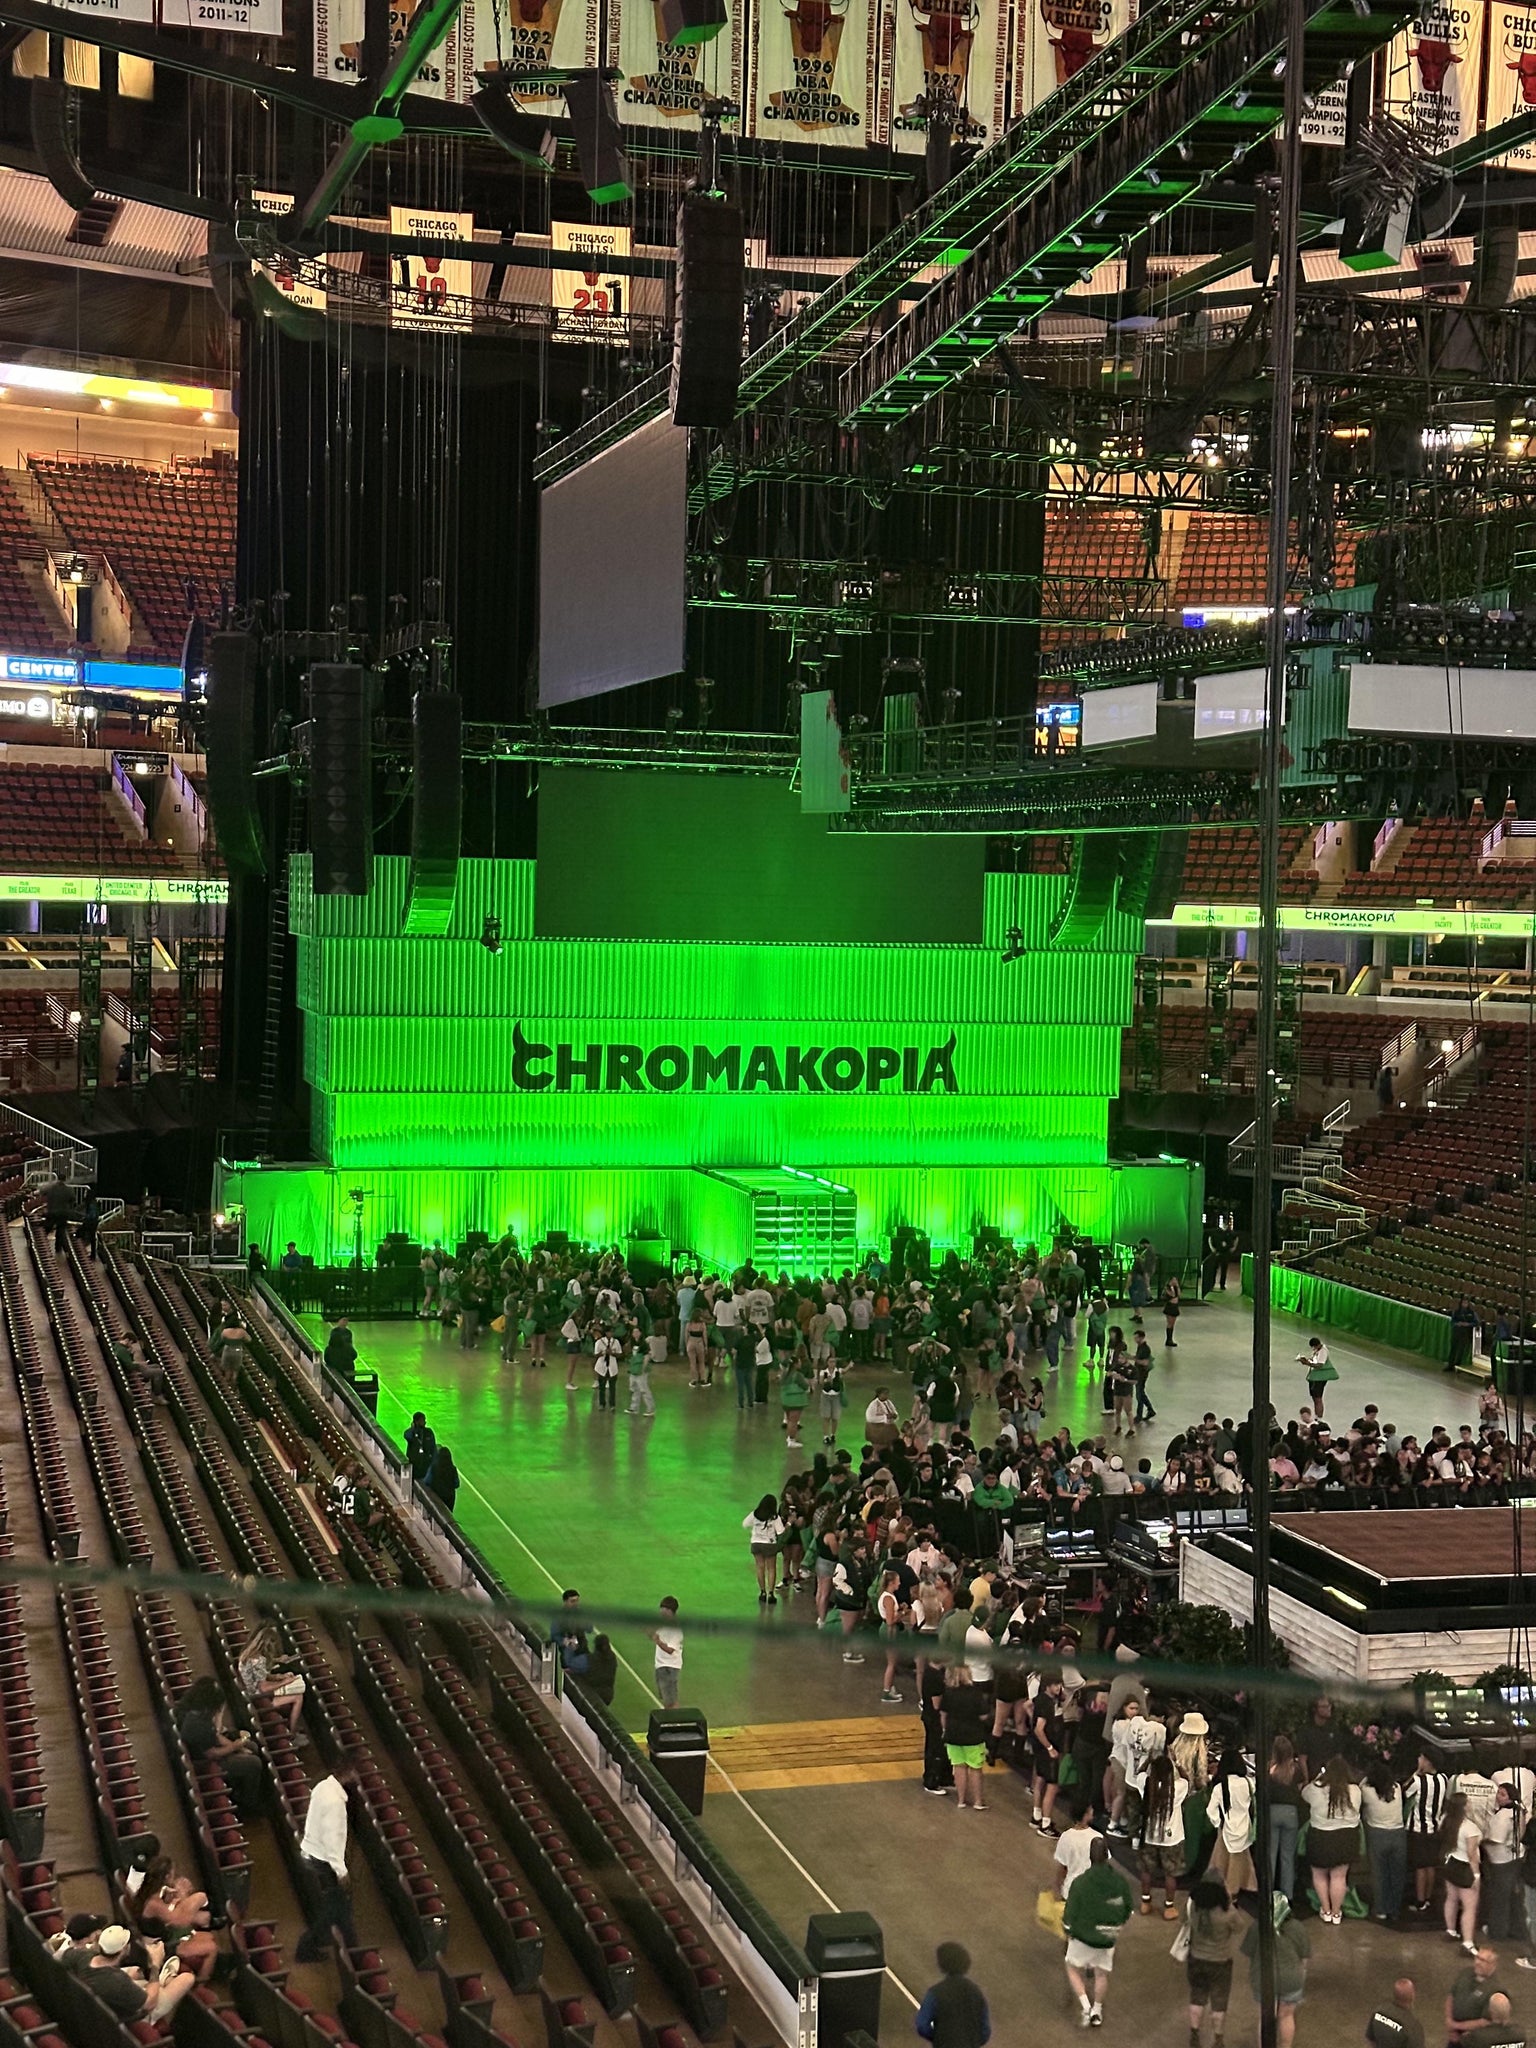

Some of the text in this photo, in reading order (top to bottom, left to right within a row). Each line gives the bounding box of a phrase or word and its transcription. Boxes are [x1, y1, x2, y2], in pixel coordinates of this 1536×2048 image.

[199, 6, 248, 23] 2011-12
[585, 6, 598, 41] HODGES
[1055, 11, 1102, 30] BULLS
[1431, 6, 1471, 24] CAGO
[463, 6, 475, 43] SCOTTIE
[1412, 21, 1460, 40] BULLS
[511, 27, 552, 45] 1992
[317, 27, 328, 64] PERDUE
[513, 45, 547, 61] NBA
[657, 42, 698, 60] 1993
[462, 47, 474, 83] PERDUE
[996, 47, 1006, 65] STEVE
[658, 59, 693, 76] NBA
[792, 58, 833, 74] 1996
[880, 64, 891, 78] BILL
[444, 66, 456, 100] JORDAN
[645, 75, 704, 93] WORLD
[795, 75, 829, 90] NBA
[924, 70, 961, 87] 1997
[623, 90, 701, 110] CHAMPIO
[783, 90, 841, 107] WORLD
[879, 88, 890, 123] SIMPKINS
[763, 106, 861, 126] CHAMPIONS
[408, 218, 457, 231] CHICAGO
[567, 232, 615, 245] CHICAGO
[573, 288, 609, 318] 23
[9, 660, 76, 678] CENTER
[1305, 907, 1396, 923] CHROMAKOPIA
[511, 1018, 960, 1092] CHROMAKOPIA
[342, 1494, 355, 1515] 12
[1374, 2012, 1403, 2033] SECURITY
